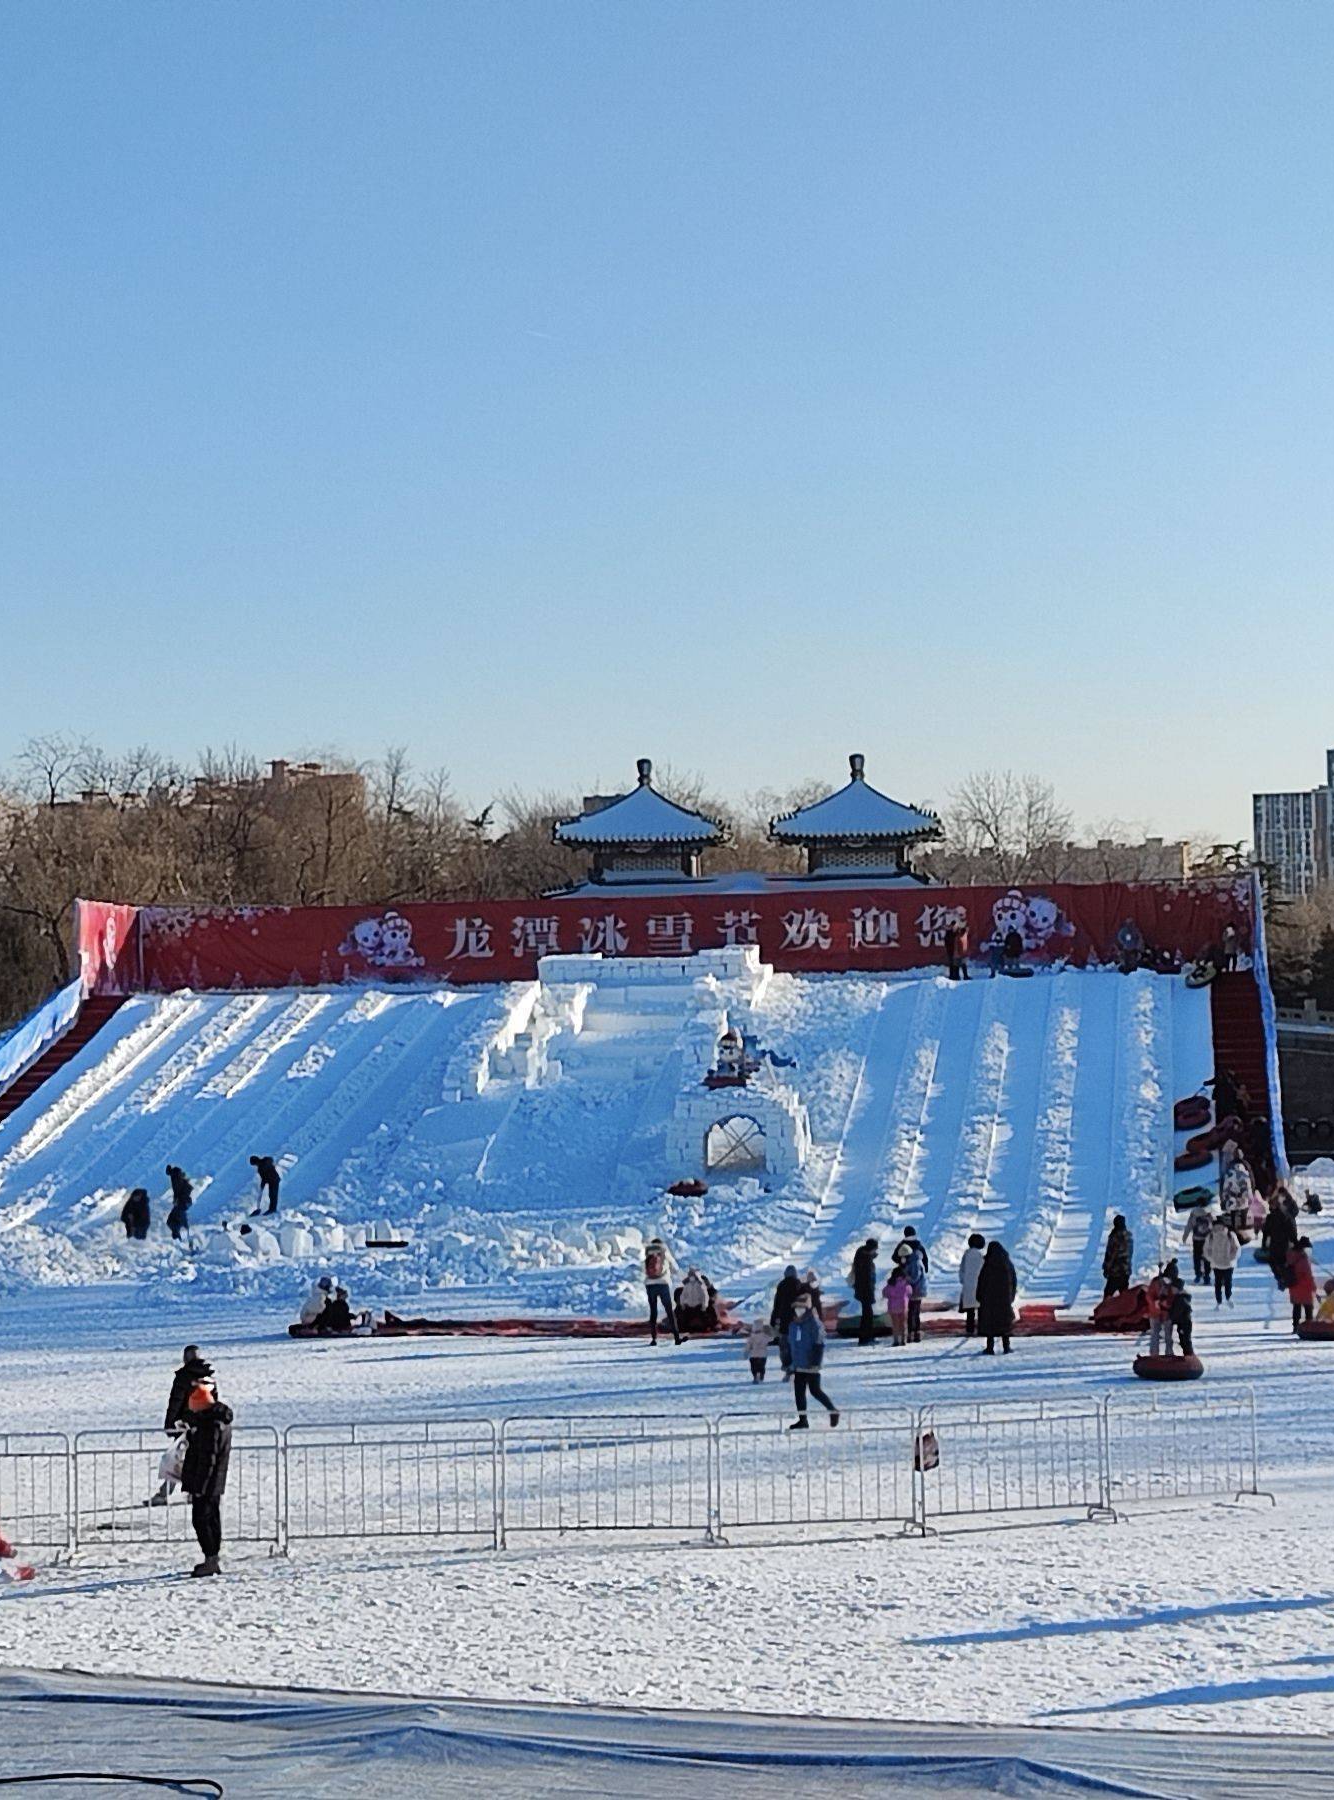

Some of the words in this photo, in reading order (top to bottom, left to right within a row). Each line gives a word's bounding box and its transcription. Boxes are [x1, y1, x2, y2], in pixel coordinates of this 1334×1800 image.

[444, 904, 967, 960] 龙潭冰雪节欢迎您
